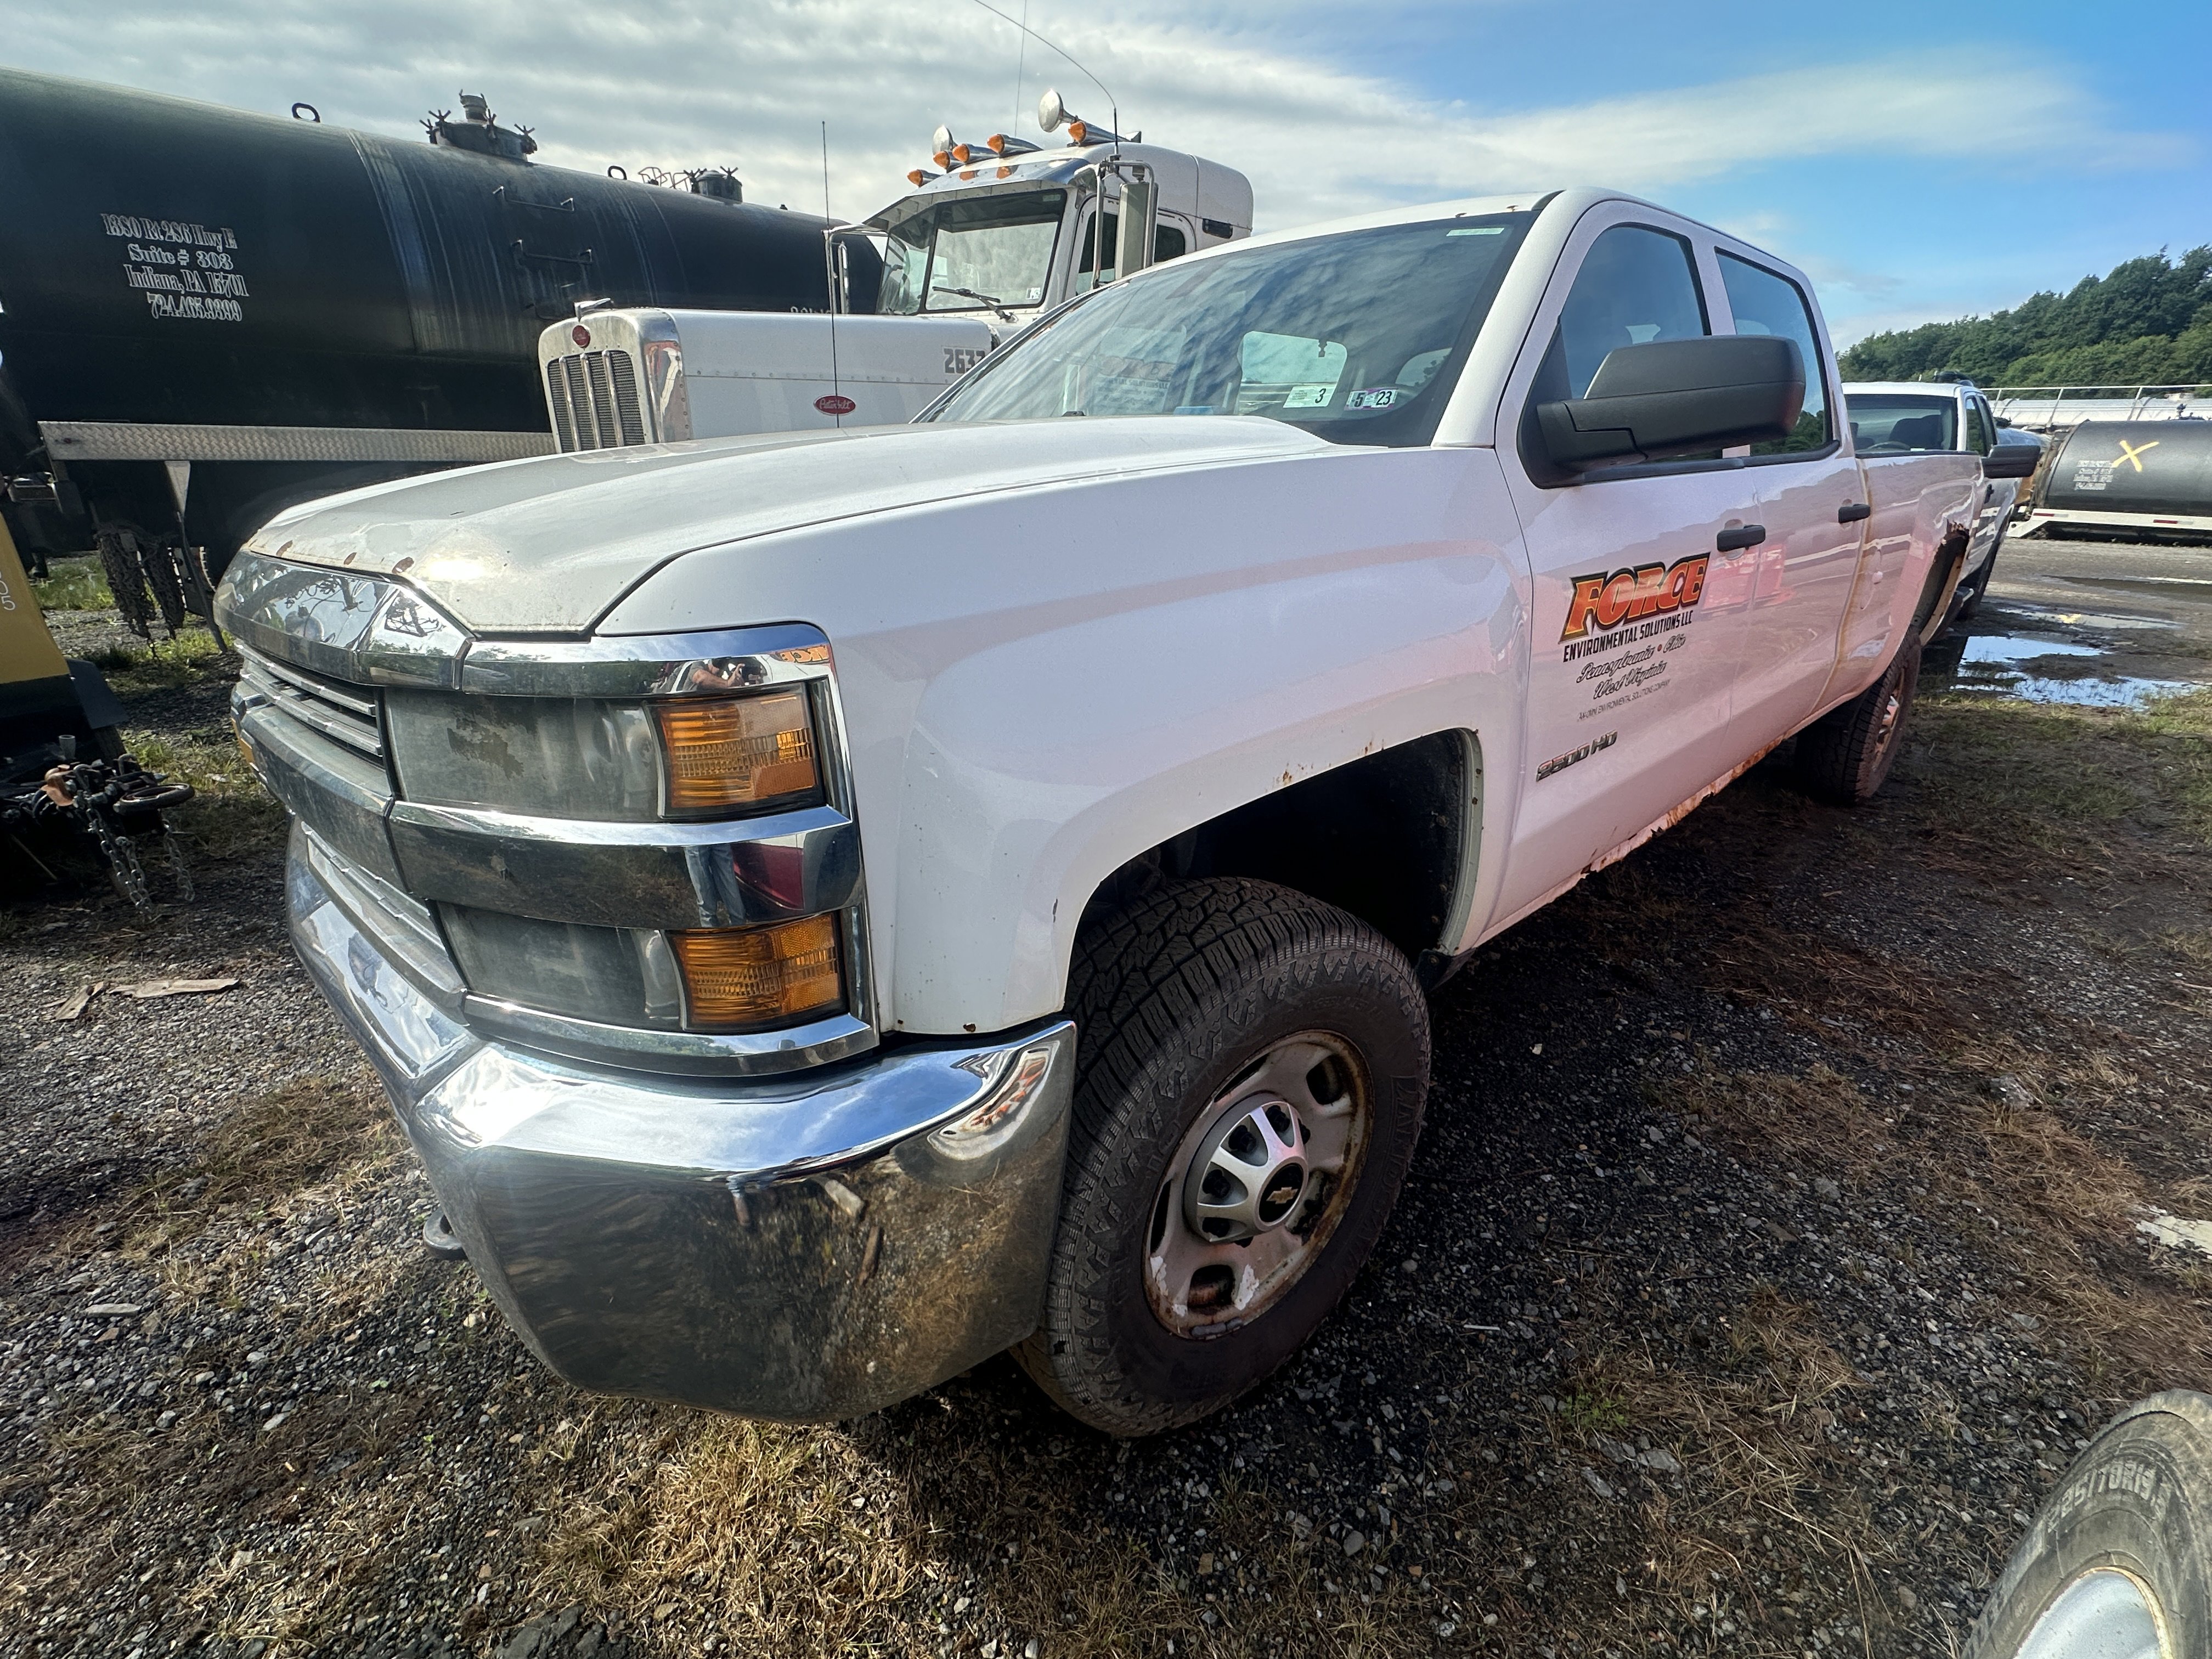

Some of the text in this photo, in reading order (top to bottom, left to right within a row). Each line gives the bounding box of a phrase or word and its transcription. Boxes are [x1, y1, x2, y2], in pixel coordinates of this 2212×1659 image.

[139, 218, 164, 241] Rt
[190, 224, 222, 252] Hwy
[221, 227, 238, 249] E
[127, 244, 233, 270] Suite # 303
[123, 264, 250, 298] Indiana, PA 15701
[1315, 388, 1327, 403] 3
[1354, 393, 1365, 407] 5
[1376, 391, 1392, 405] 23
[1559, 552, 1711, 644] FORCE
[1563, 610, 1694, 662] ENVIRONMENTAL SOLUTIONS LLC
[1576, 634, 1686, 683] Pennsylvania Ohio
[1593, 660, 1667, 699] West Virginia
[1536, 729, 1618, 782] 2500 HD
